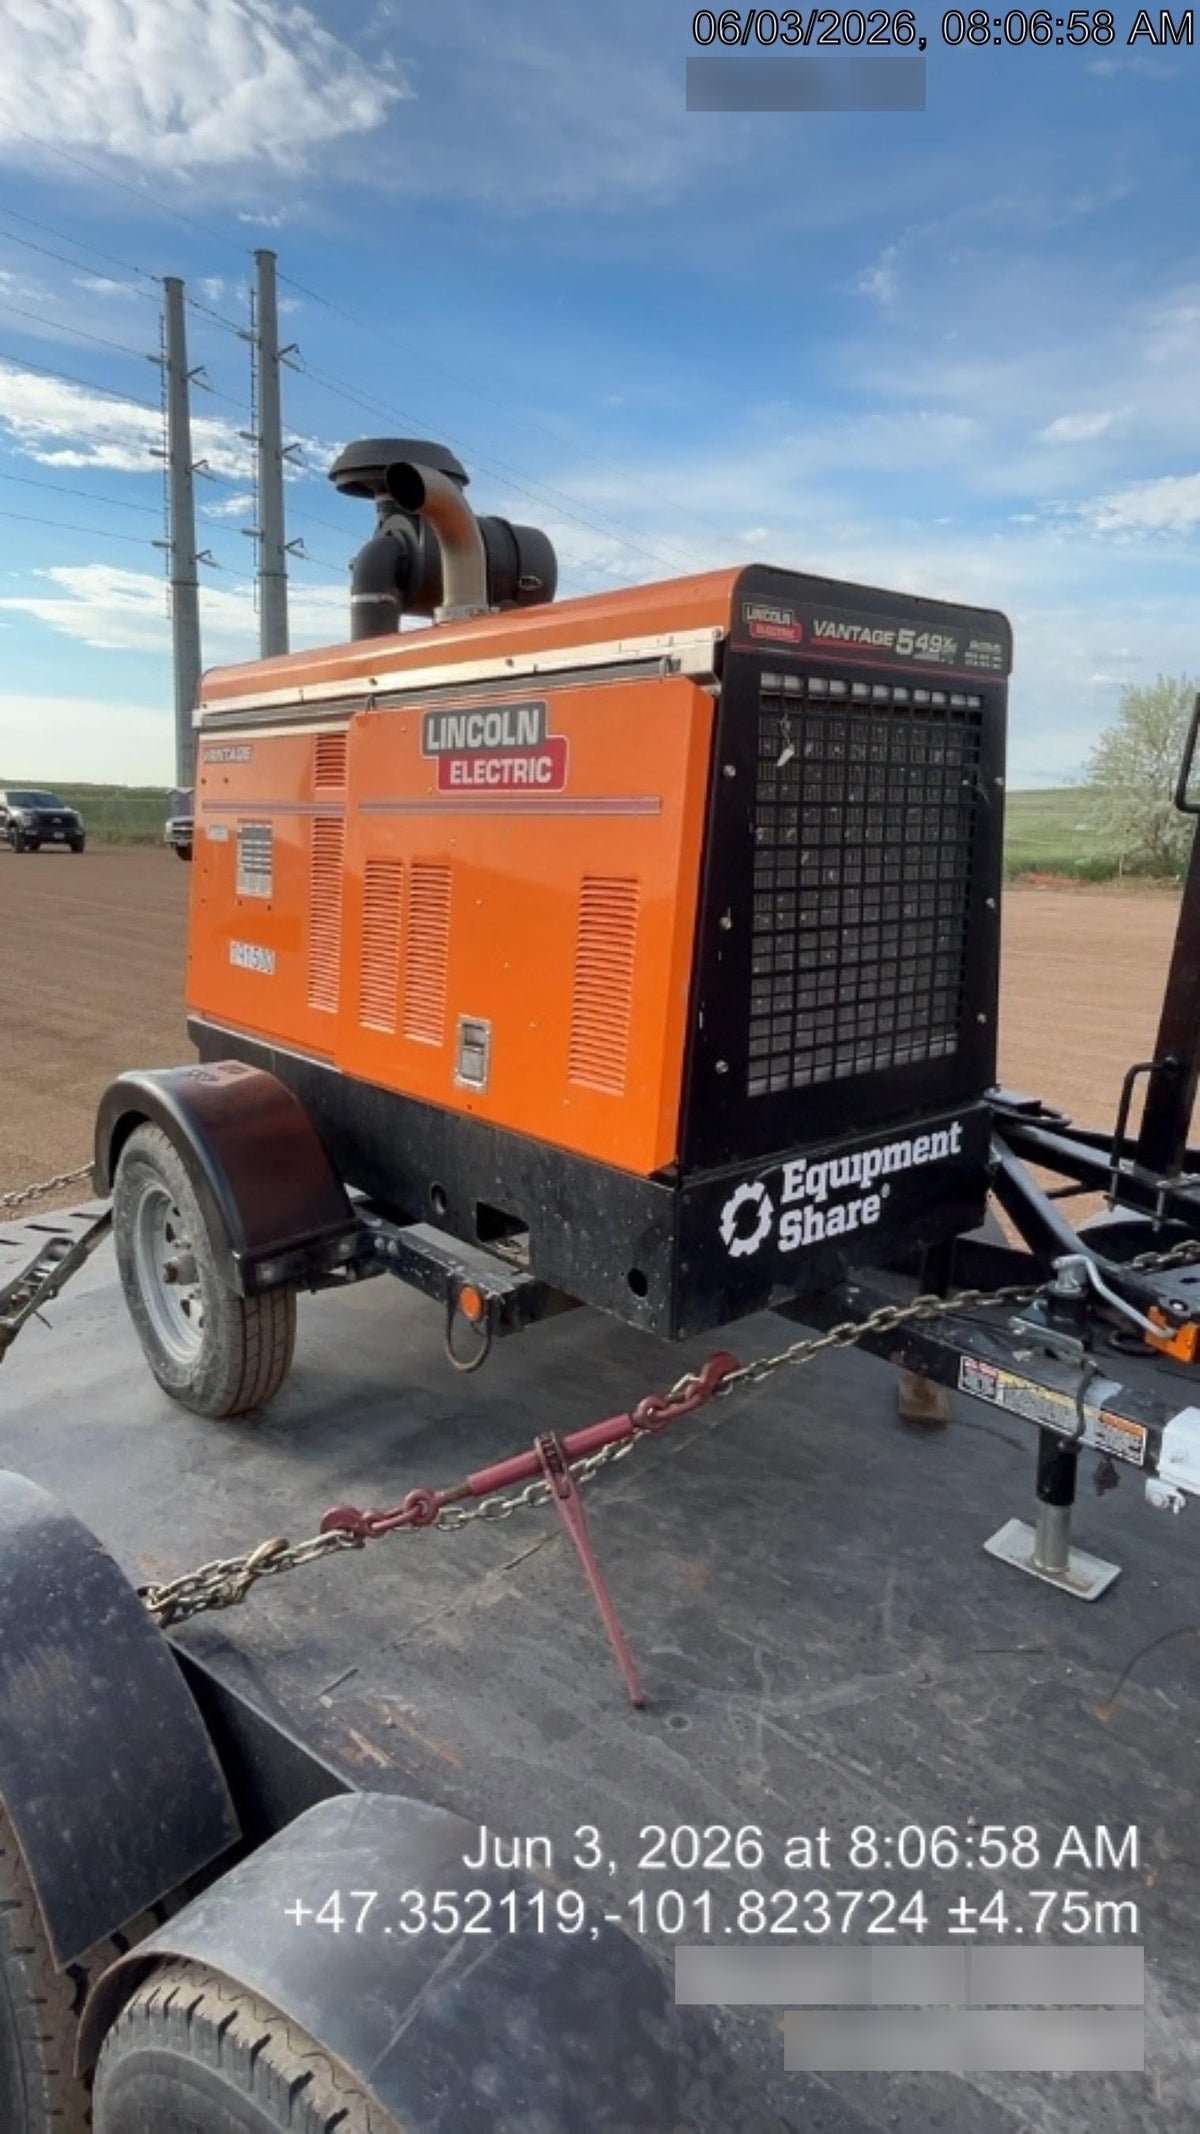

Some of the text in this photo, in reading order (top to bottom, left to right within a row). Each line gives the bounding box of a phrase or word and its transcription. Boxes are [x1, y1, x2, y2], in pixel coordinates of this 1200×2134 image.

[813, 619, 896, 647] VANTAGE
[427, 709, 540, 750] LINCOLN
[450, 756, 554, 785] ELECTRIC
[780, 1121, 963, 1204] Equipment
